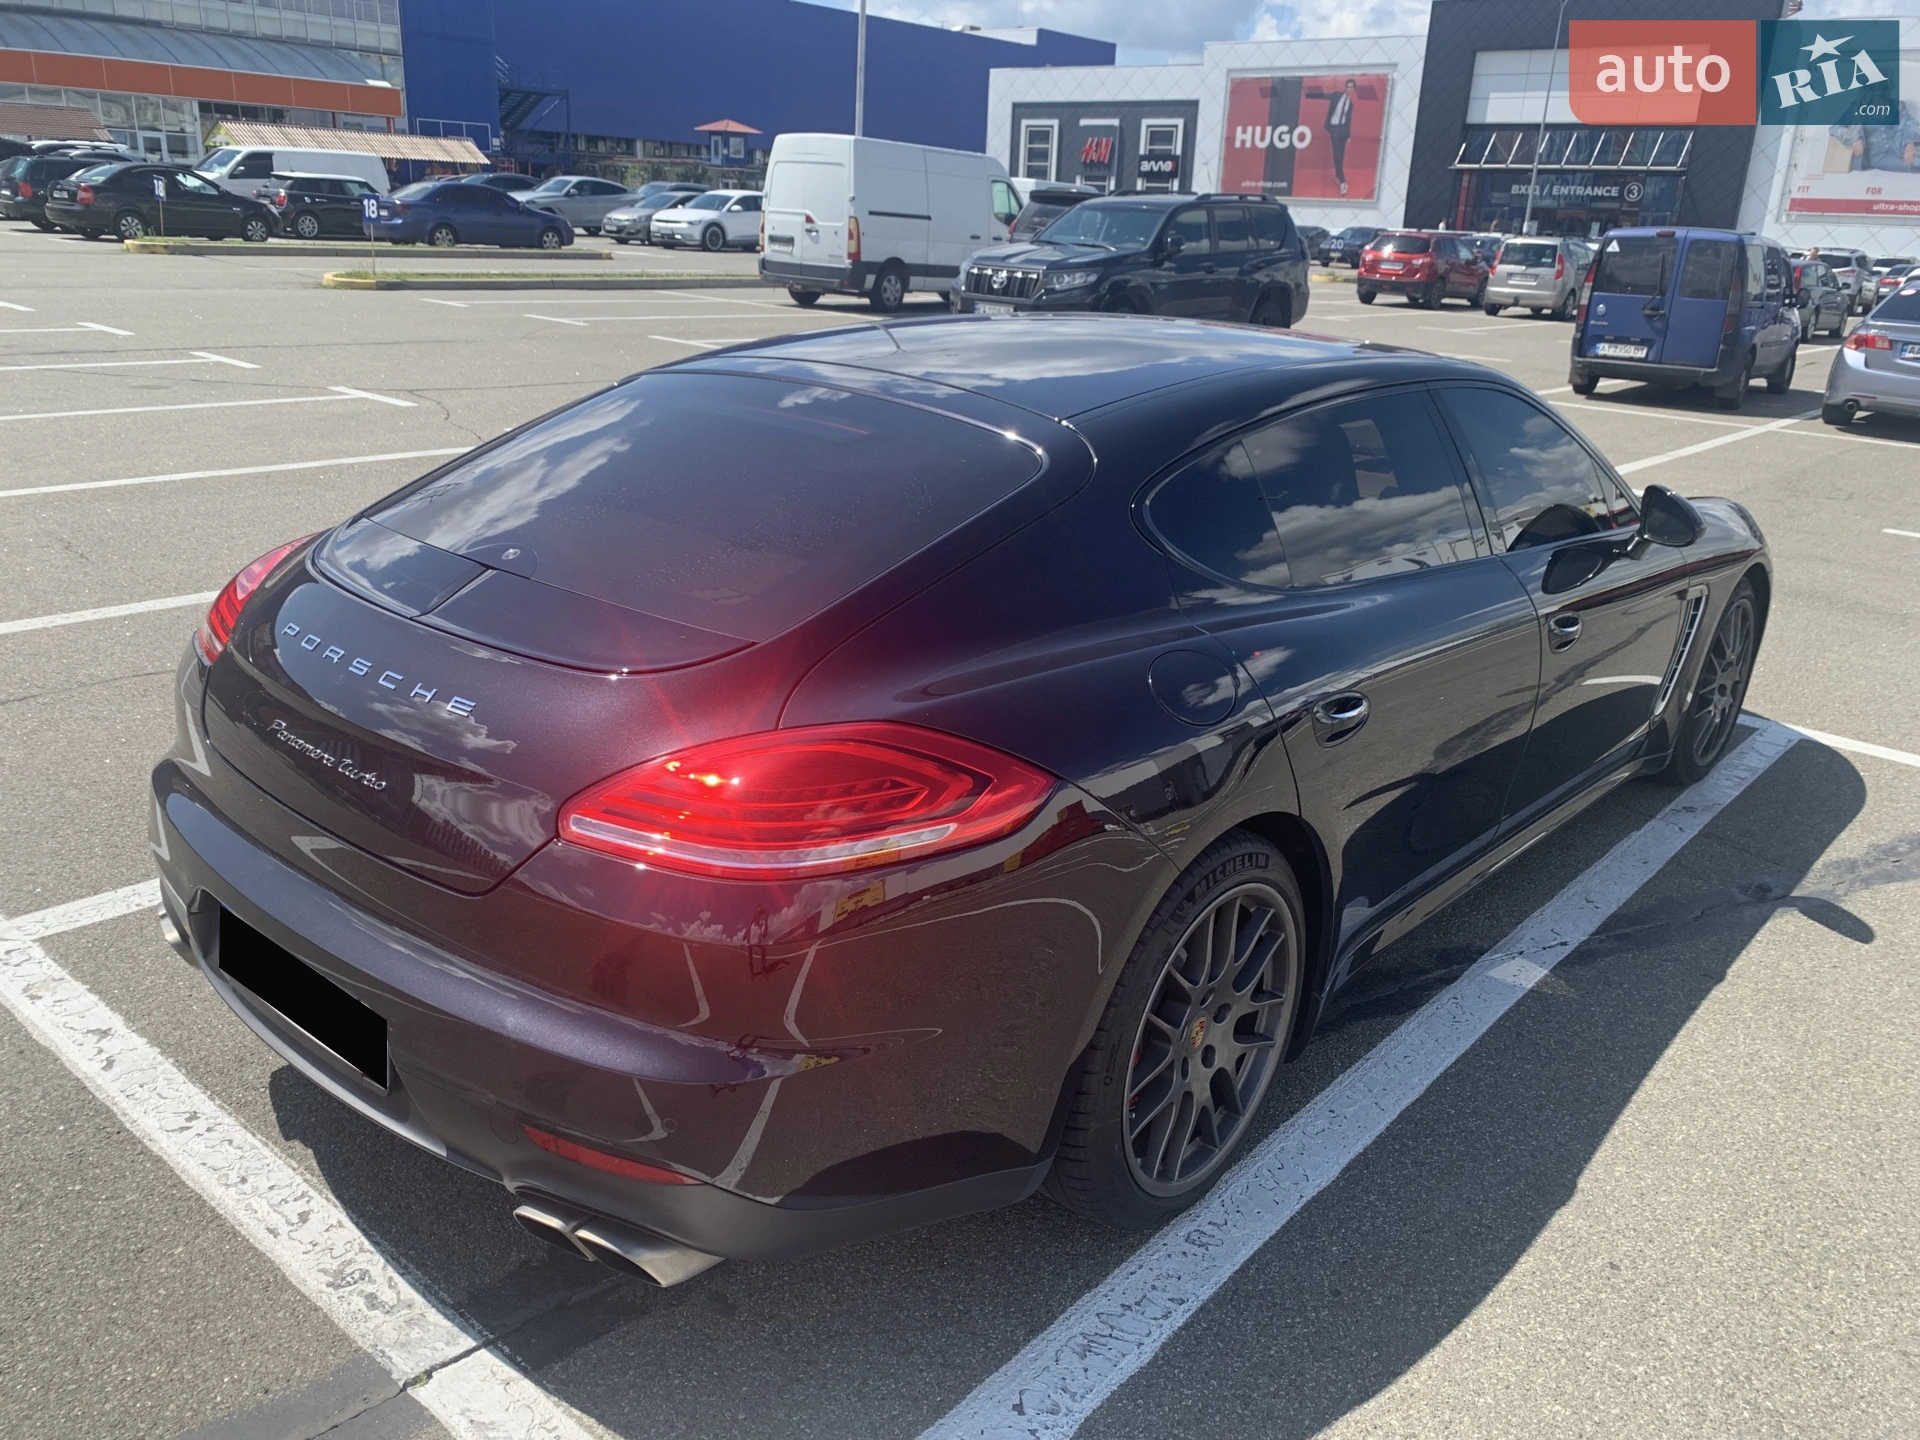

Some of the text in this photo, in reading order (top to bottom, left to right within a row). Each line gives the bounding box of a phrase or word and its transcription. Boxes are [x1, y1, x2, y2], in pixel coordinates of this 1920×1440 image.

[1234, 124, 1313, 150] HUGO
[153, 179, 164, 198] 18
[1241, 180, 1288, 188] ultra-shop.com
[1552, 185, 1620, 197] ENTRANCE
[1866, 187, 1883, 195] FOR
[363, 198, 378, 218] 18
[1330, 239, 1344, 249] 20
[281, 622, 476, 717] PORSCHE
[267, 719, 387, 791] Panamera Turbo
[1195, 853, 1267, 901] MICHELIN
